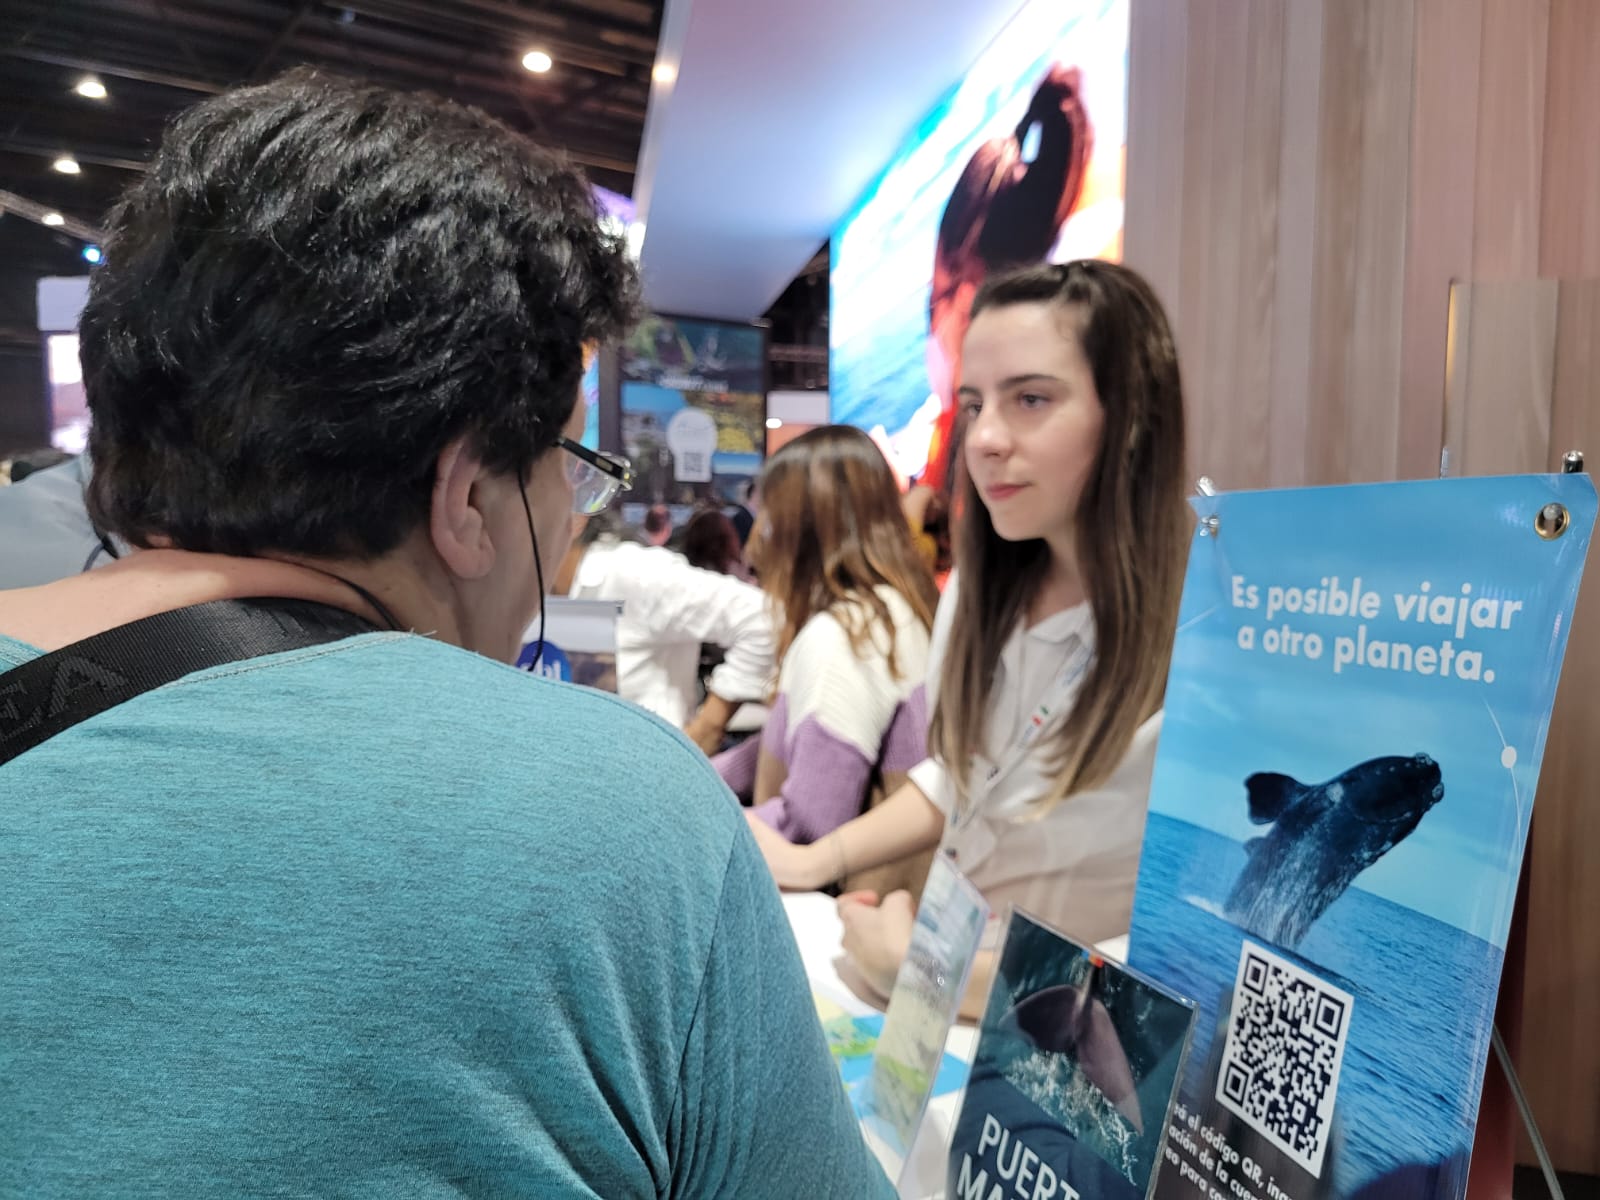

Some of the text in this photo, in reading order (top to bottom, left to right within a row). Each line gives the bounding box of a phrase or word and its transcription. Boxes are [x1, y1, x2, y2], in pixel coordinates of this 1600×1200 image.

[1231, 575, 1523, 639] Es posible viajar
[1237, 624, 1496, 684] a otro planeta.
[1168, 1125, 1198, 1157] ación
[1198, 1148, 1215, 1171] de
[1215, 1160, 1230, 1184] la
[1179, 1160, 1208, 1192] para
[1187, 1114, 1201, 1131] el
[1200, 1125, 1240, 1165] código
[1241, 1156, 1265, 1188] QR,
